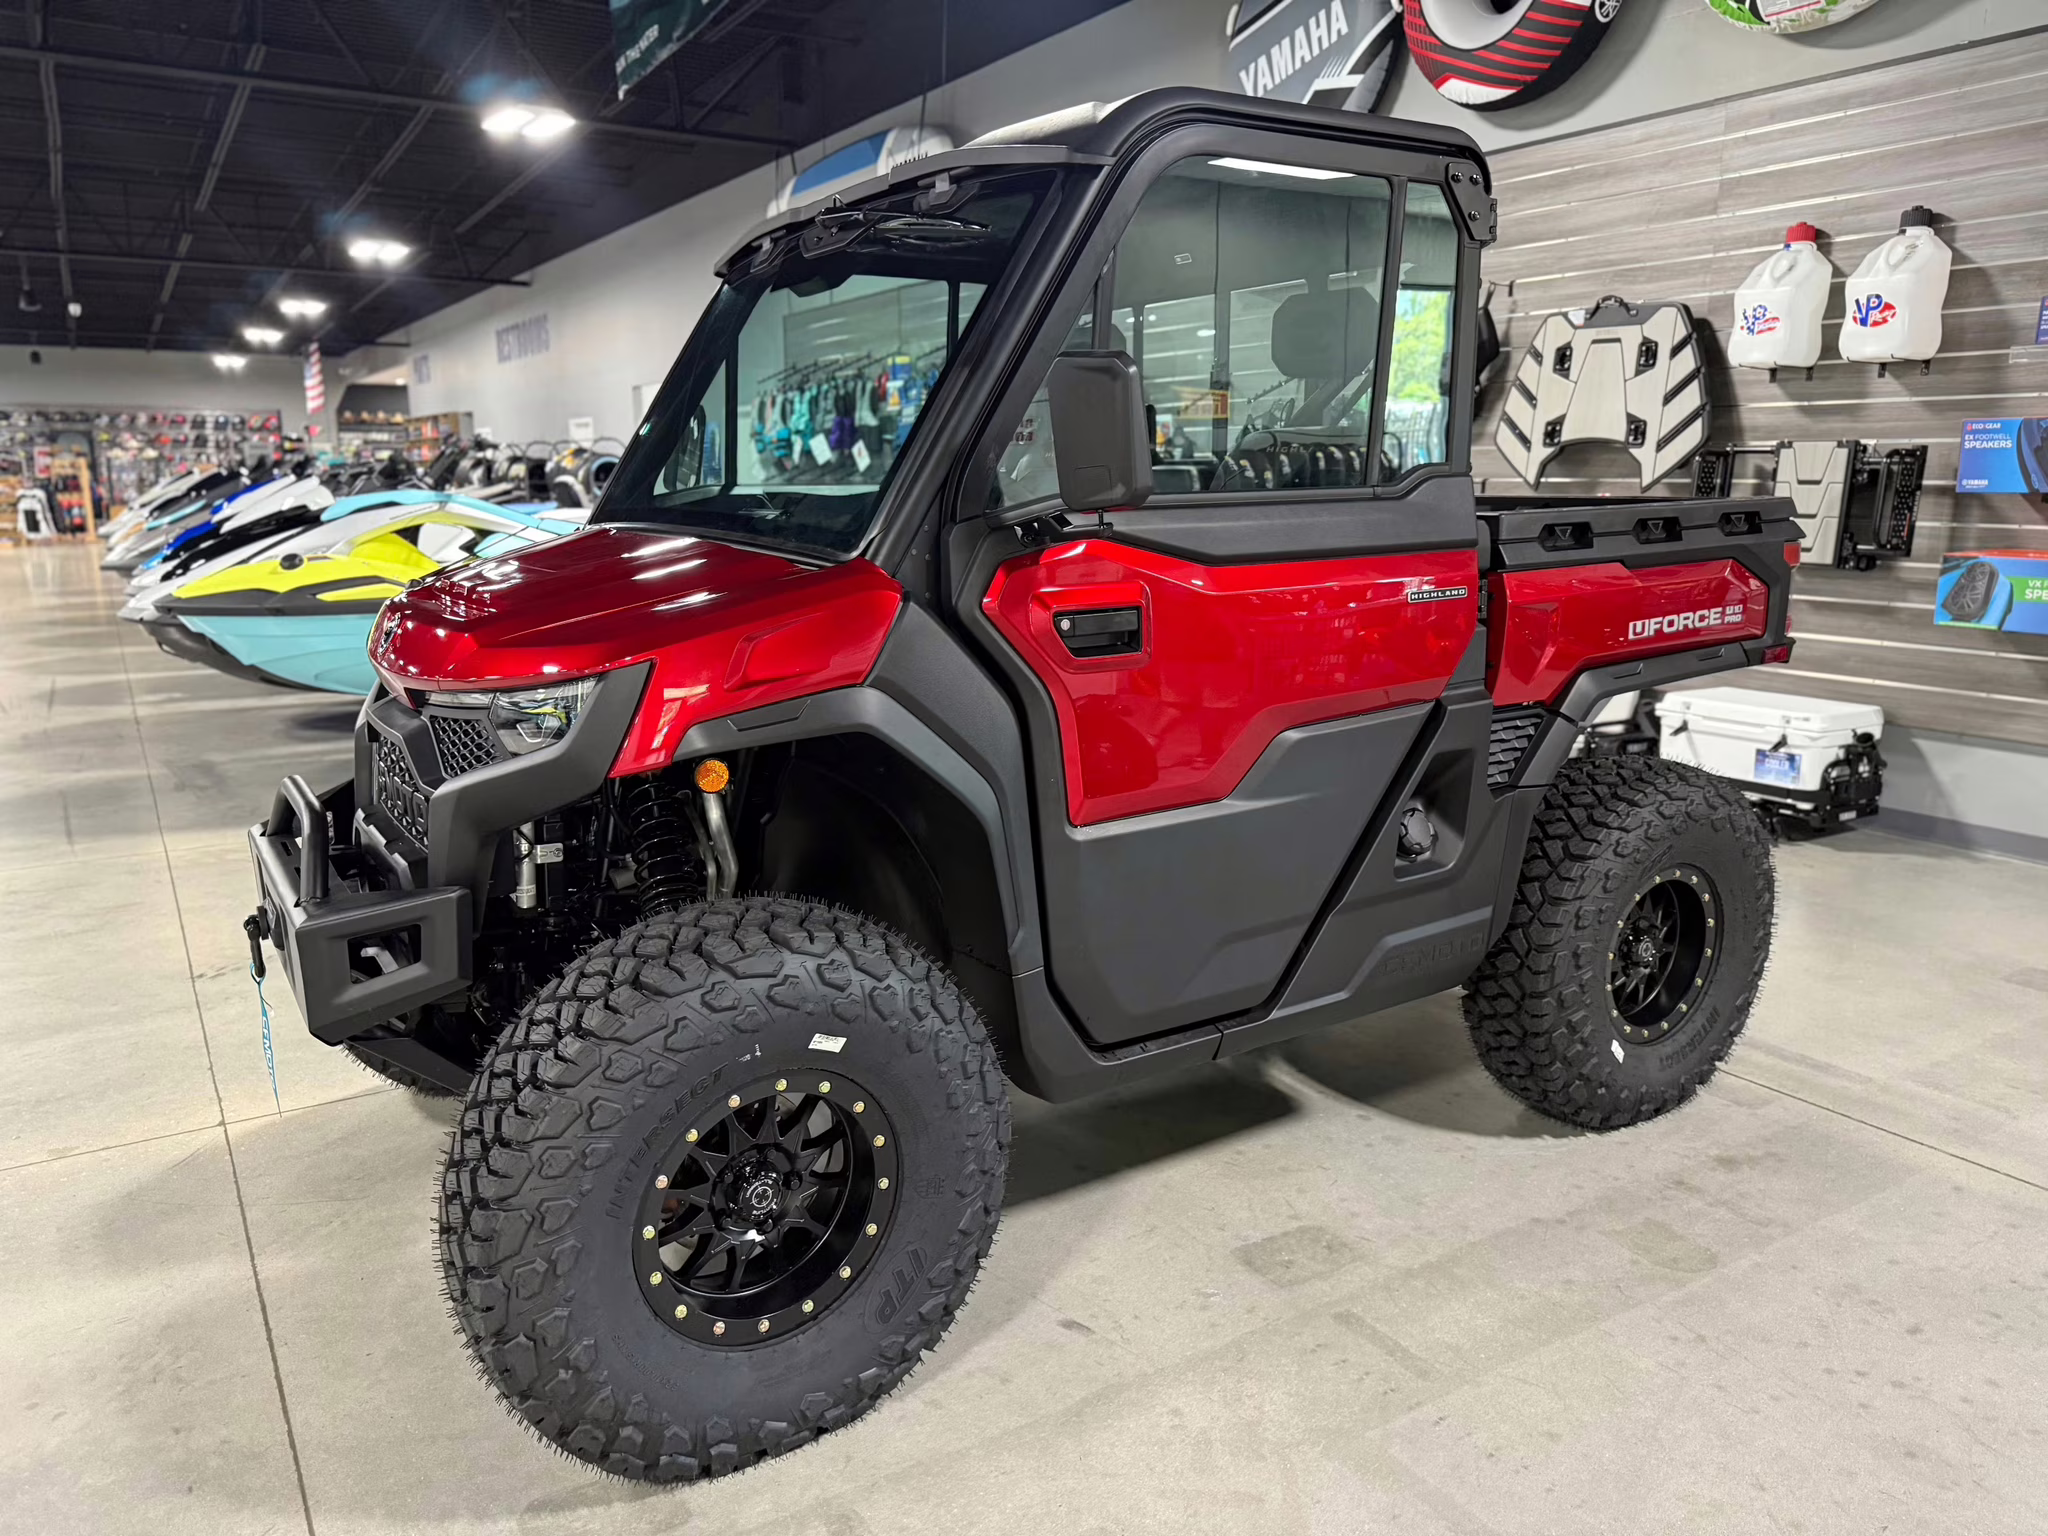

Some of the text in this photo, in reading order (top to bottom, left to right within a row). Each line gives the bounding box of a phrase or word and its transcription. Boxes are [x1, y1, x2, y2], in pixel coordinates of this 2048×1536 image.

[1238, 0, 1349, 97] YAMAHA
[1854, 293, 1883, 327] VP
[1964, 440, 2012, 449] SPEAKERS
[1411, 588, 1465, 600] HIGHLAND
[2028, 579, 2041, 588] VX
[1628, 607, 1722, 640] UFORCE
[1724, 614, 1742, 624] PRO
[605, 1061, 729, 1219] INTERSECT
[875, 1248, 925, 1325] ITP
